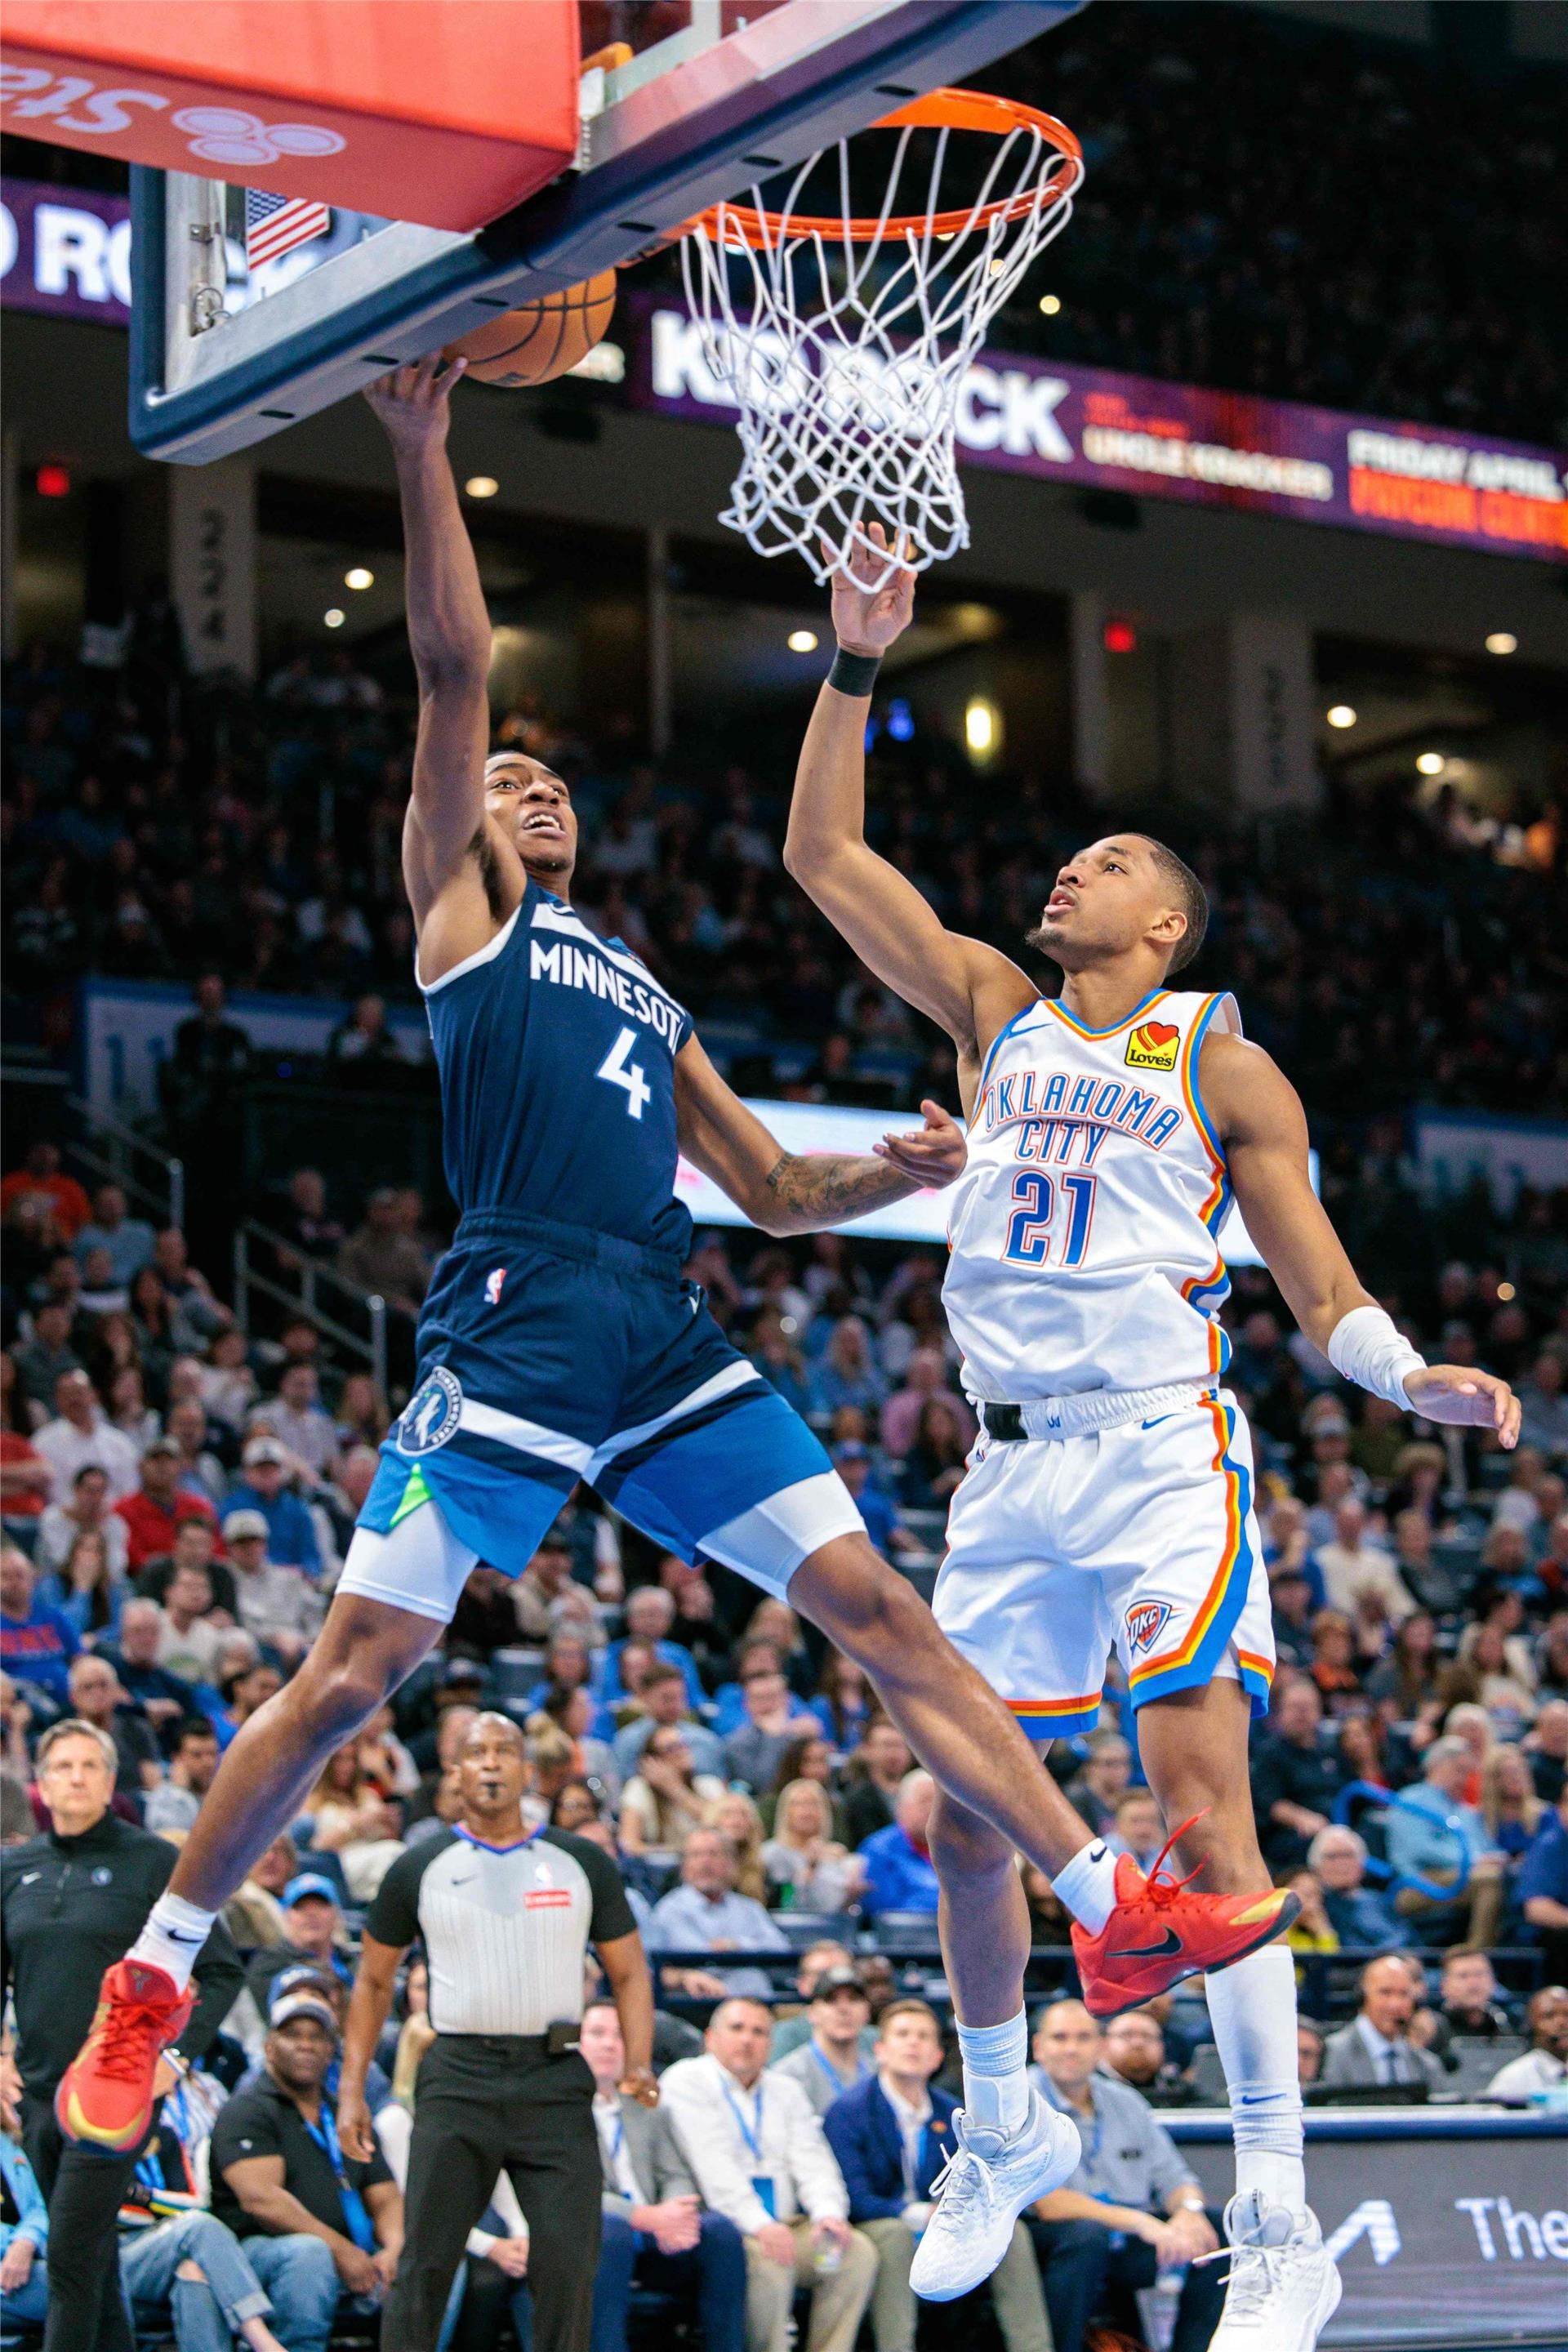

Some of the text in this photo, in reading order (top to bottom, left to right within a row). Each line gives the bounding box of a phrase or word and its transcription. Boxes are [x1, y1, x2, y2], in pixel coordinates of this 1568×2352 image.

[1348, 429, 1468, 485] FRIDAY
[595, 1024, 651, 1120] 4
[985, 1071, 1184, 1152] OKLAHOMA
[1015, 1118, 1111, 1168] CITY
[1000, 1168, 1098, 1269] 21
[1129, 1607, 1159, 1648] OKC
[1454, 2195, 1568, 2261] The
